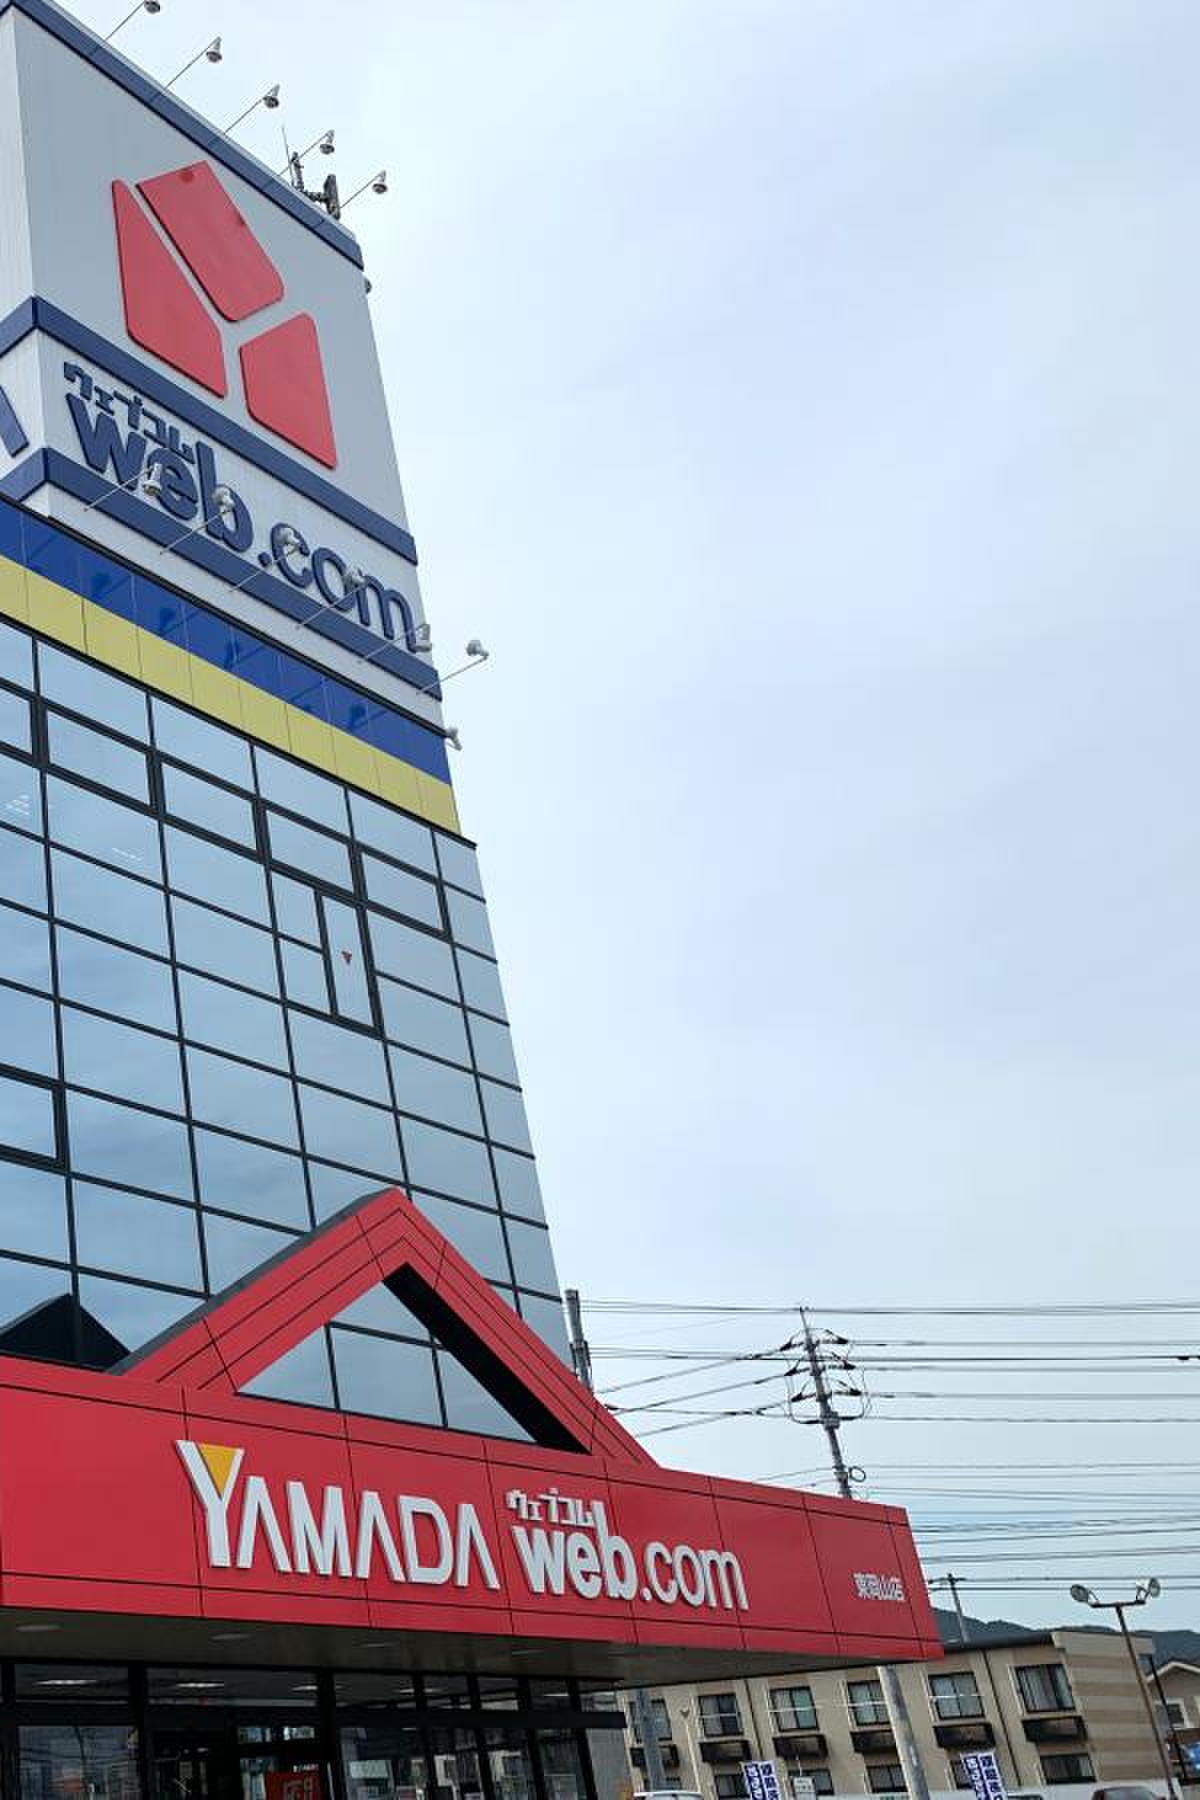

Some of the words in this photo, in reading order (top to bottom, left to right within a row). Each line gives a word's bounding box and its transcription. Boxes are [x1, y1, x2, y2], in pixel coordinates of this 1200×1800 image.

[66, 392, 418, 654] web.com
[176, 1440, 500, 1589] YAMADA
[512, 1501, 748, 1610] web.com
